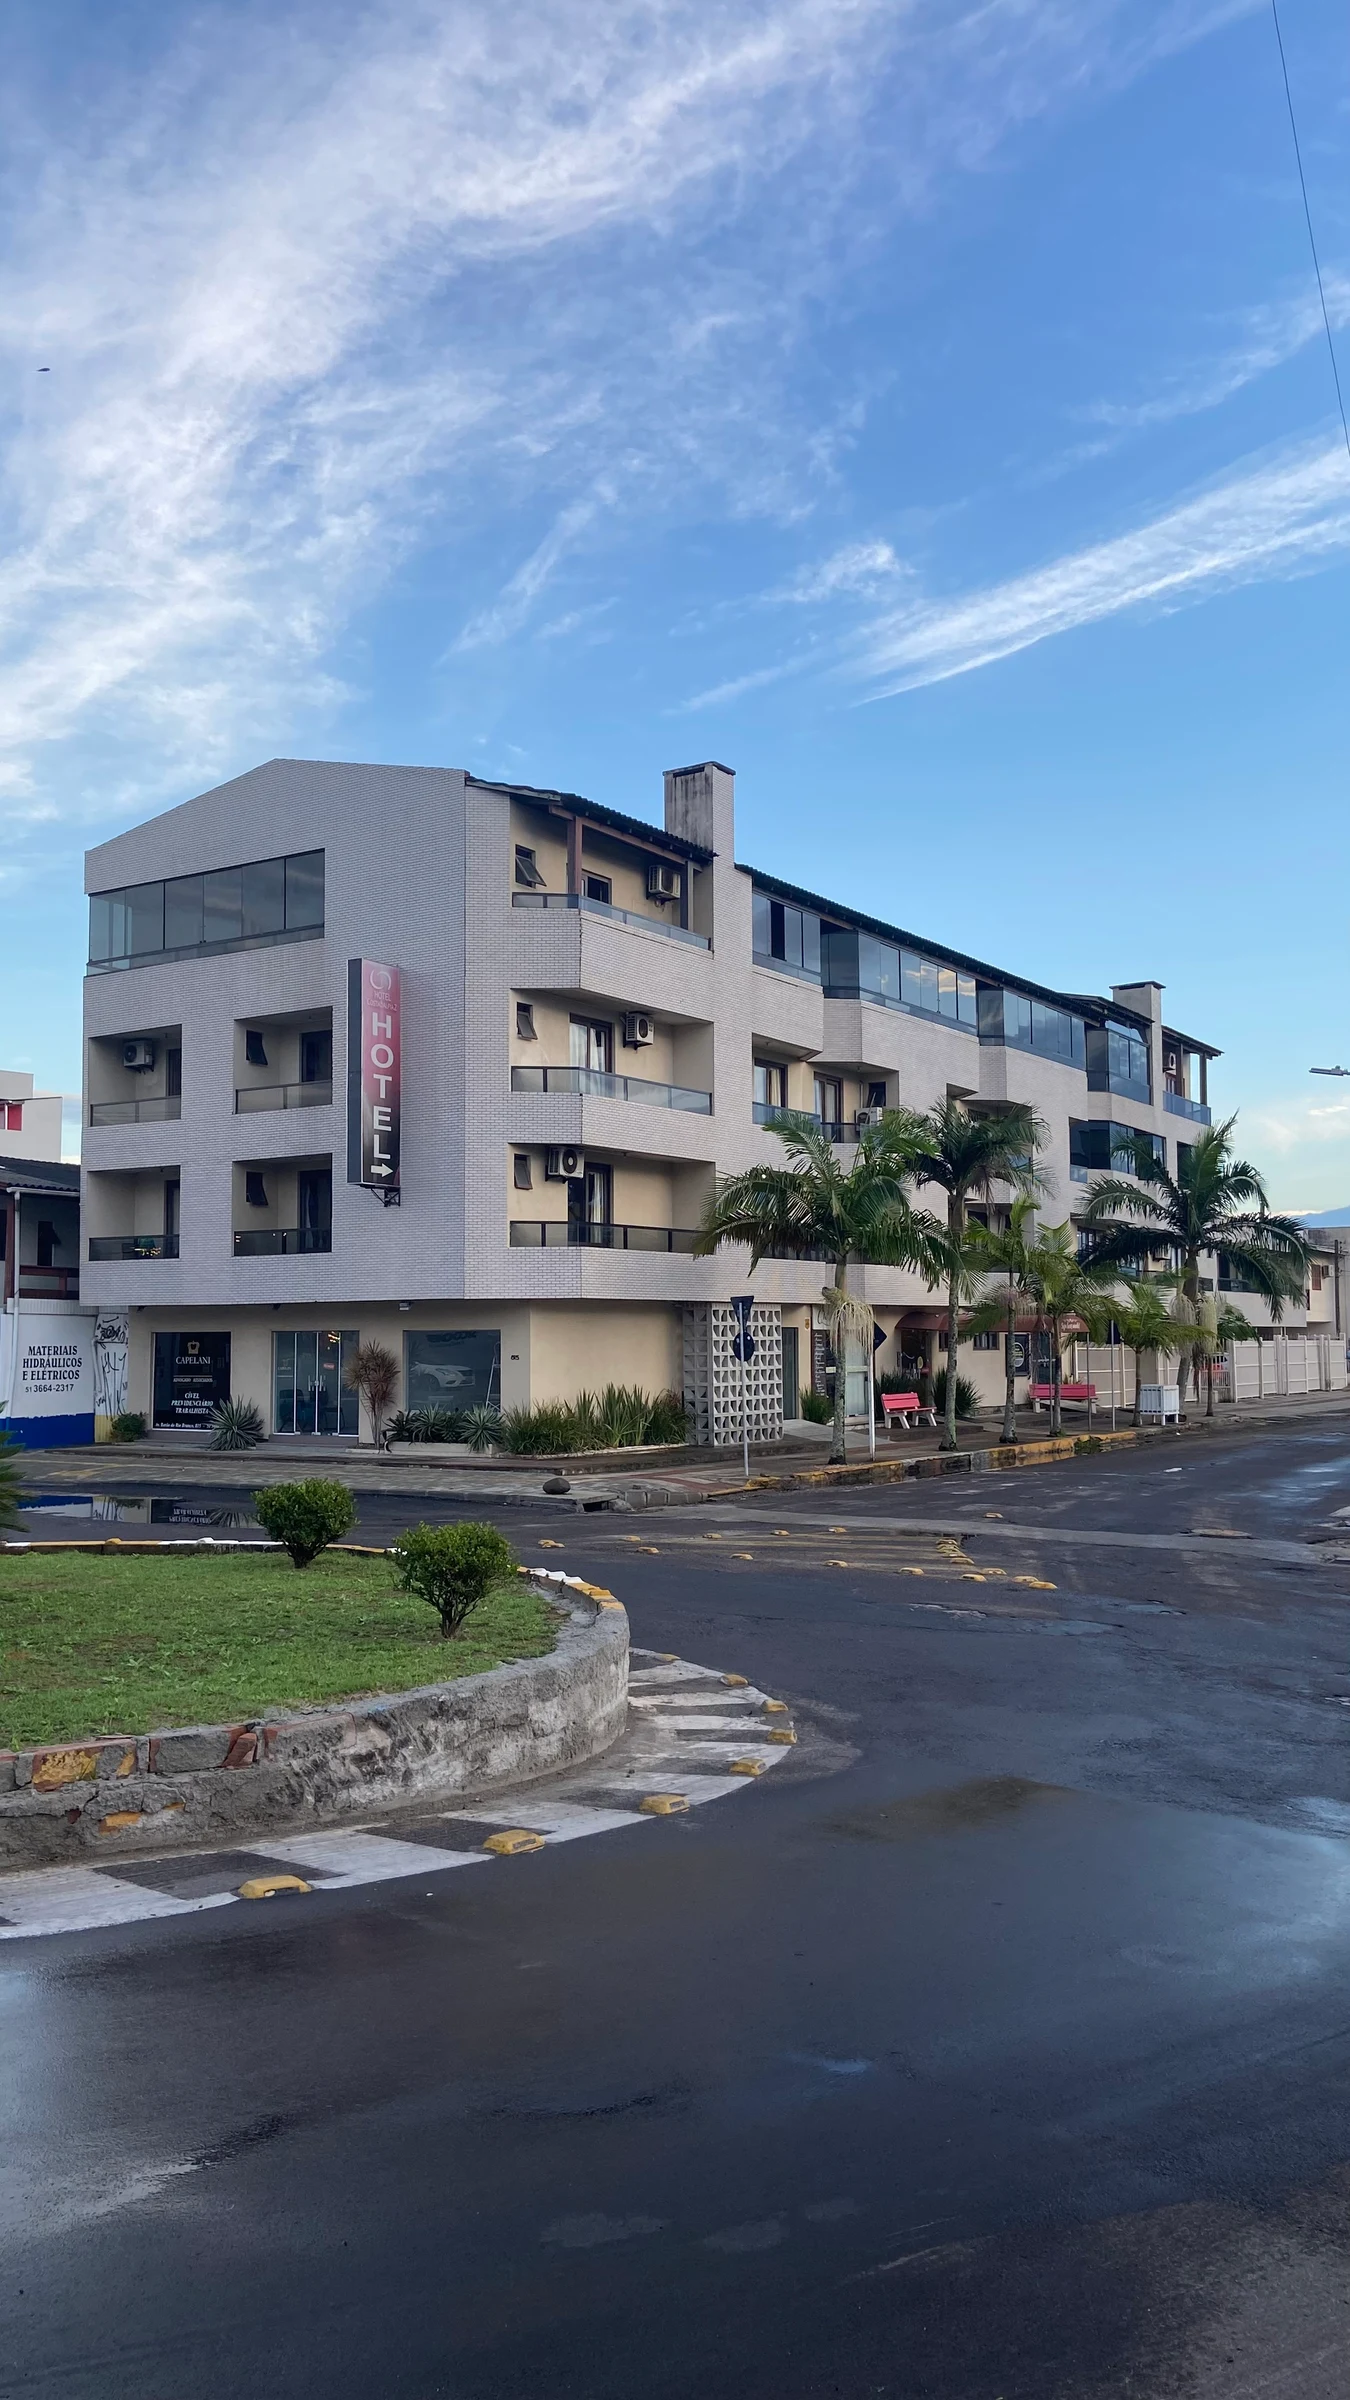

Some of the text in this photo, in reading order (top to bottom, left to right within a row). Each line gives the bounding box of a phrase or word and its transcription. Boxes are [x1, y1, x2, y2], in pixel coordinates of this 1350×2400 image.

[374, 991, 392, 1001] HOTEL
[370, 1012, 394, 1160] HOTEL
[28, 1345, 78, 1356] MATERIAIS
[22, 1355, 83, 1369] HIDRÁULICOS
[175, 1356, 211, 1364] CAPELANI
[22, 1367, 80, 1381] E ELÉTRICOS
[33, 1383, 74, 1393] 3664-2317
